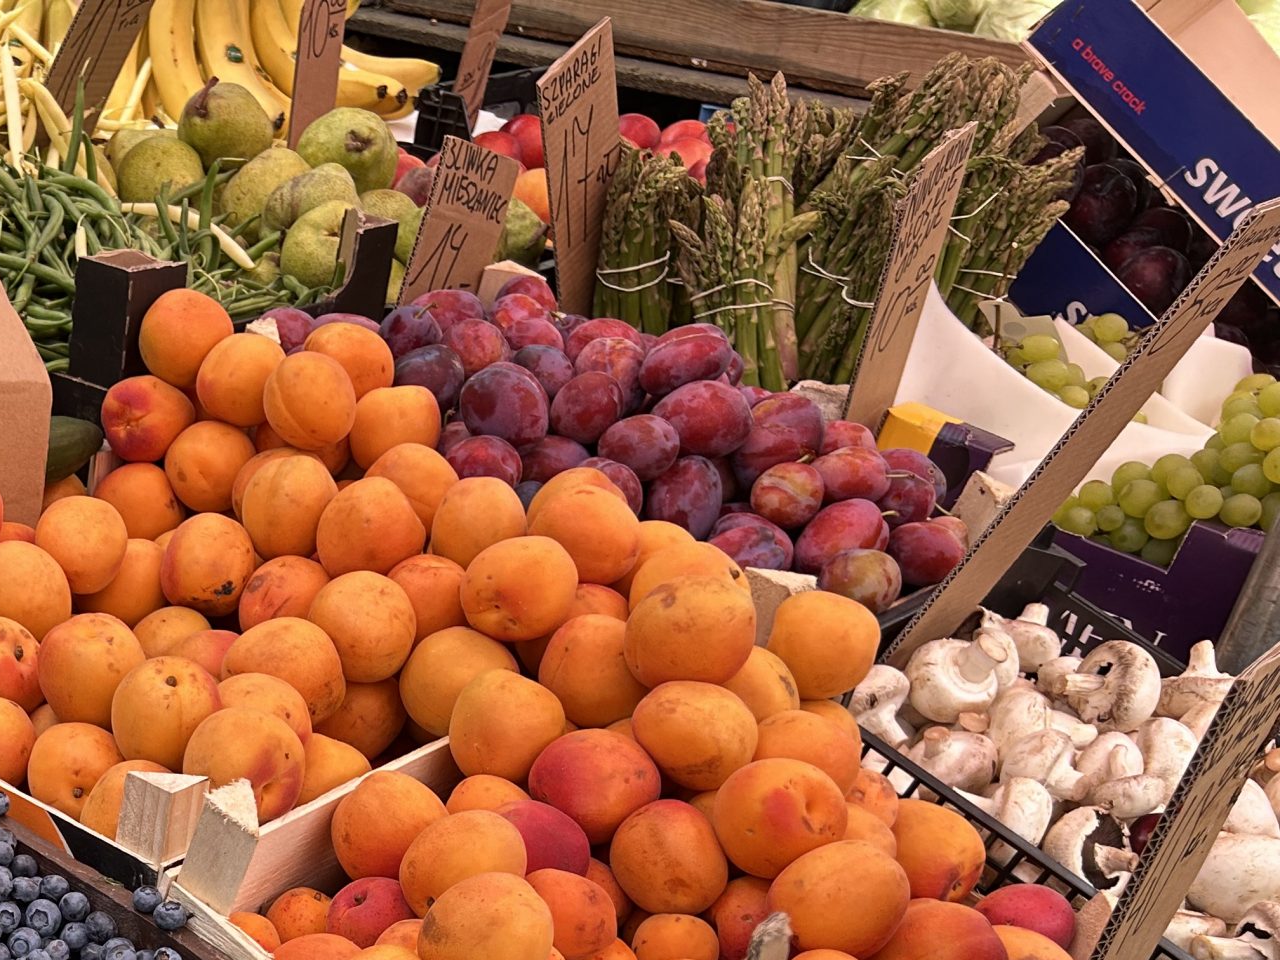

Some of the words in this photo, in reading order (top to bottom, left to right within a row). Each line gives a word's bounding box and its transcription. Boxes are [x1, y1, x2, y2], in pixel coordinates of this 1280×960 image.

[541, 34, 603, 111] SZPARAGI
[1072, 37, 1083, 50] a
[1081, 45, 1114, 84] brave
[1112, 78, 1147, 116] crack
